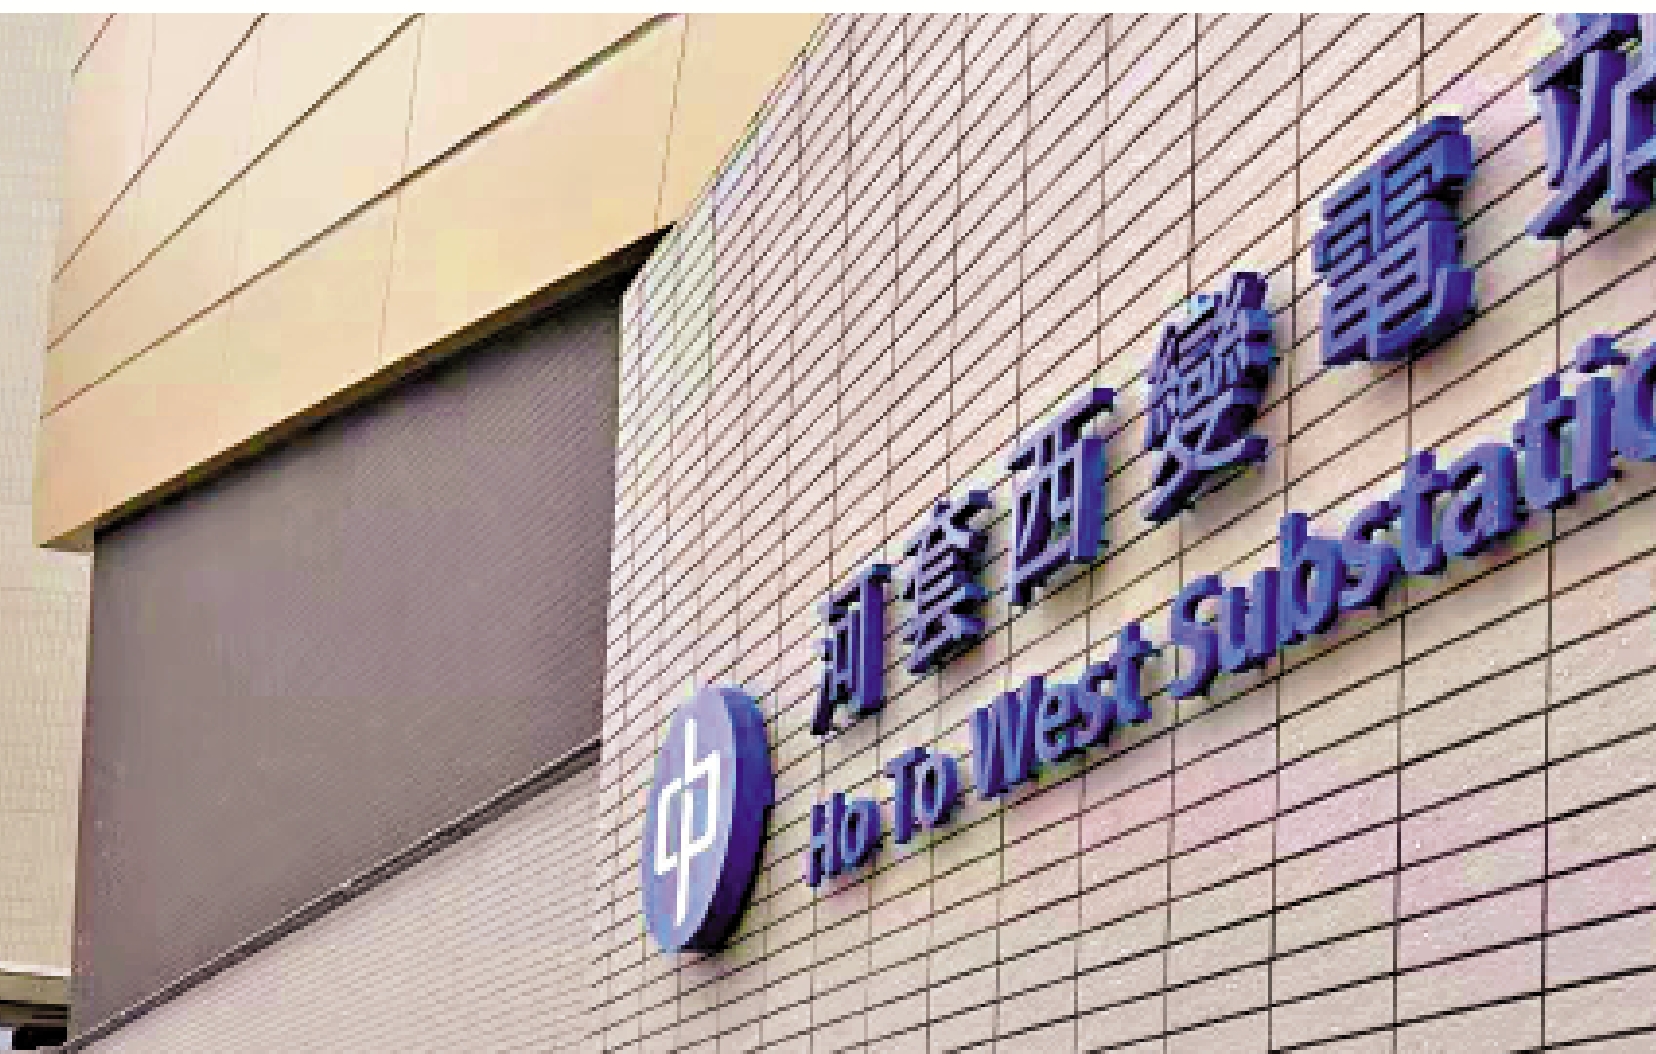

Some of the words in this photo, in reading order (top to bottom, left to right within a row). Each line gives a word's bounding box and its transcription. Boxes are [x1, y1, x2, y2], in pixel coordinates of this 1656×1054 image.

[808, 793, 882, 888] Ho
[885, 747, 962, 843] To
[972, 622, 1160, 800] West
